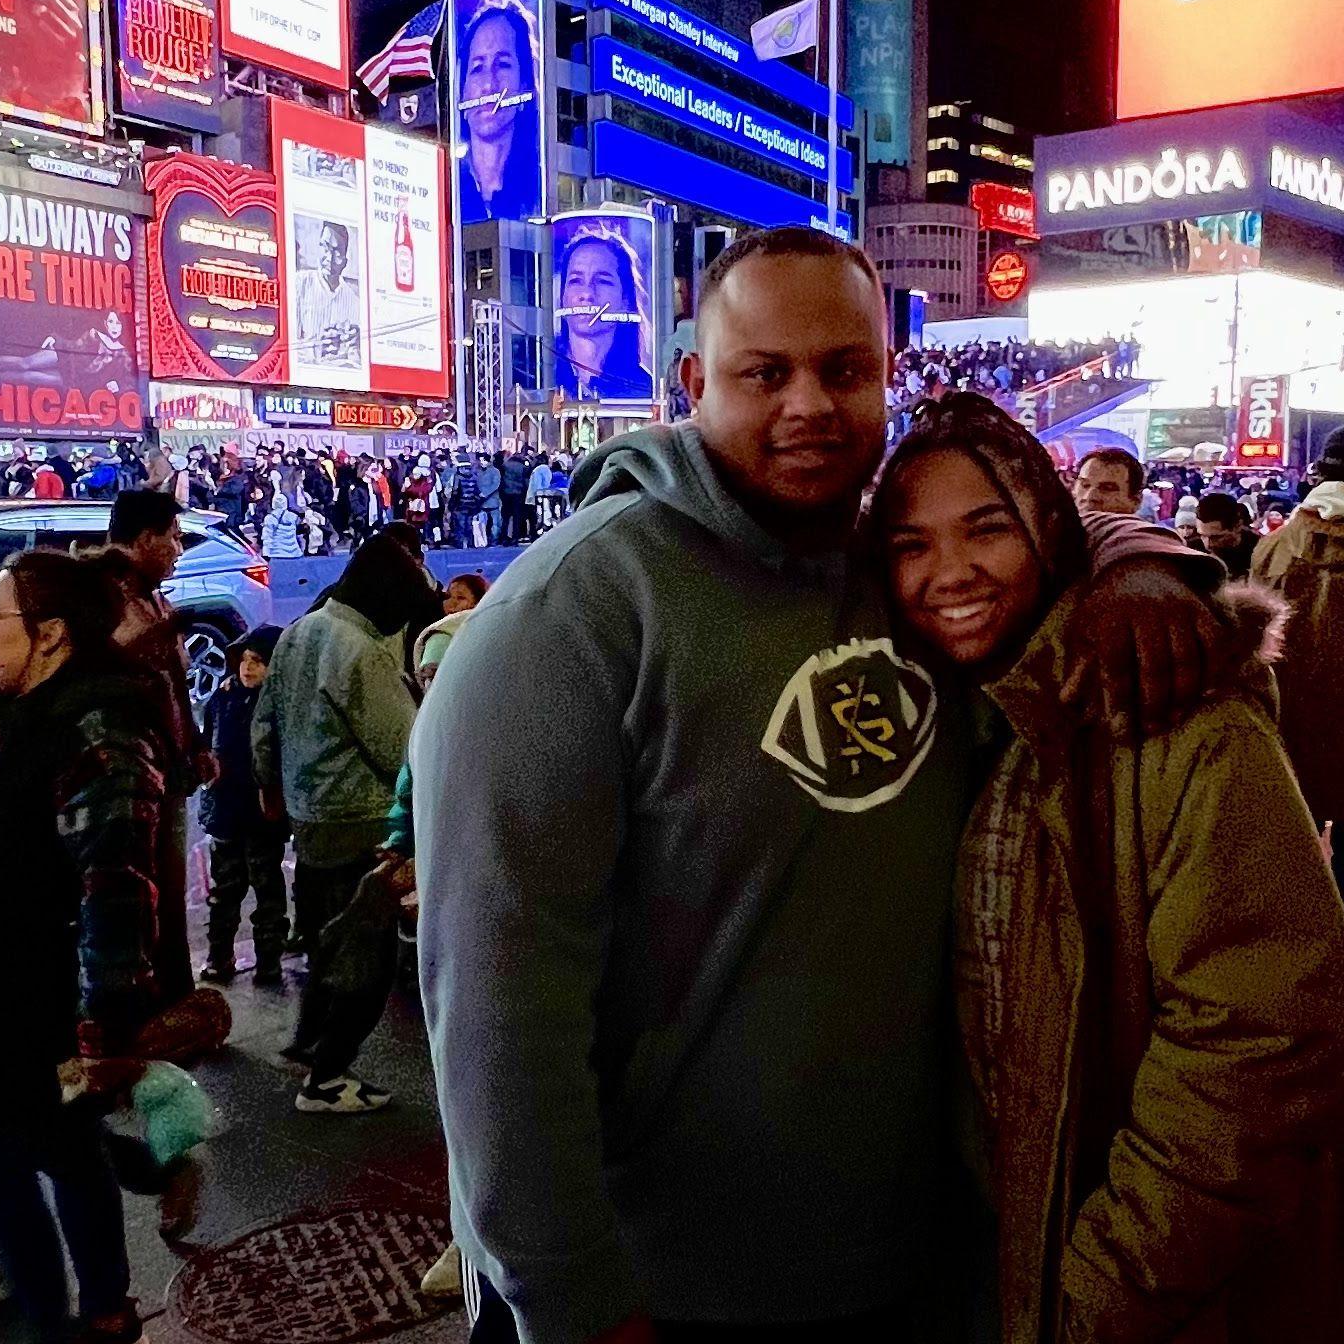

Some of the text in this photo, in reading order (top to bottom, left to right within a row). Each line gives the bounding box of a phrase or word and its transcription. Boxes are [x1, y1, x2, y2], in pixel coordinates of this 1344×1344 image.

[668, 11, 702, 46] Stanley
[702, 29, 739, 63] Interview
[612, 53, 686, 109] Exceptional
[688, 88, 734, 130] Leaders
[743, 114, 804, 162] Exceptional
[800, 142, 826, 172] Ideas
[1047, 147, 1248, 215] PANDORA
[40, 251, 133, 314] THING
[265, 395, 331, 415] BLUE FIN
[337, 404, 358, 423] DOS
[1248, 378, 1273, 440] tkts
